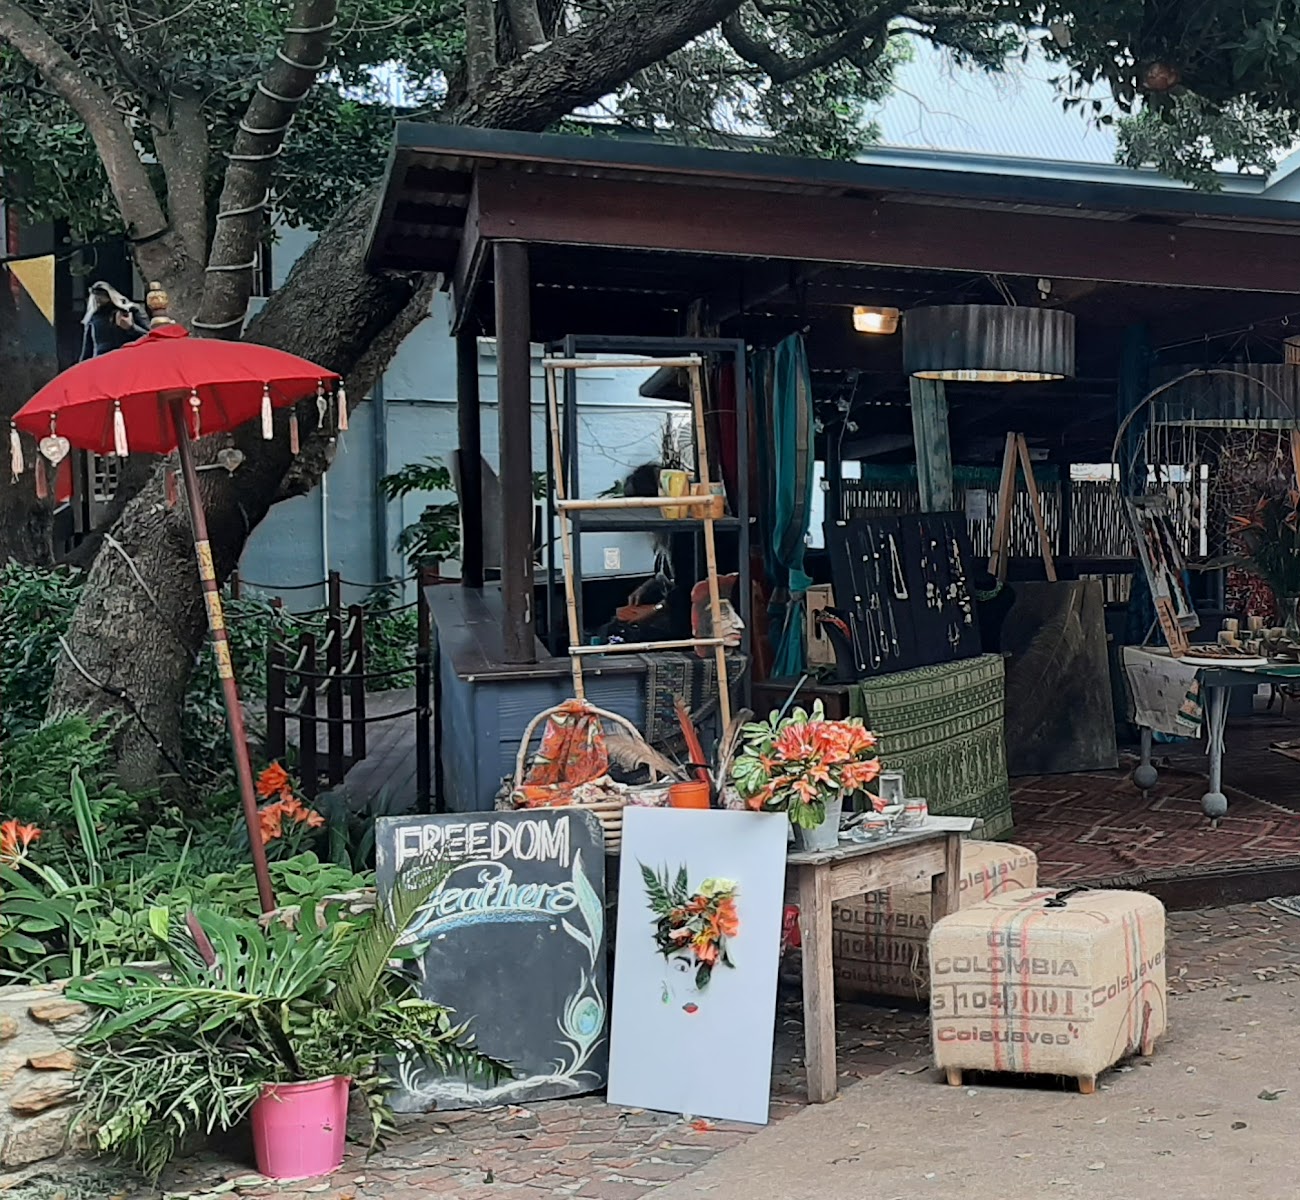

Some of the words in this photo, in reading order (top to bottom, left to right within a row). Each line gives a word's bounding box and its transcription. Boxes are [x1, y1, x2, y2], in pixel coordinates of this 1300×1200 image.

[395, 815, 570, 872] FREEDOM
[960, 855, 1037, 892] olsuaves
[864, 889, 890, 904] DE
[987, 930, 1022, 948] DE
[934, 956, 1079, 977] COLOMBIA
[937, 1026, 1071, 1046] Colsuaves
